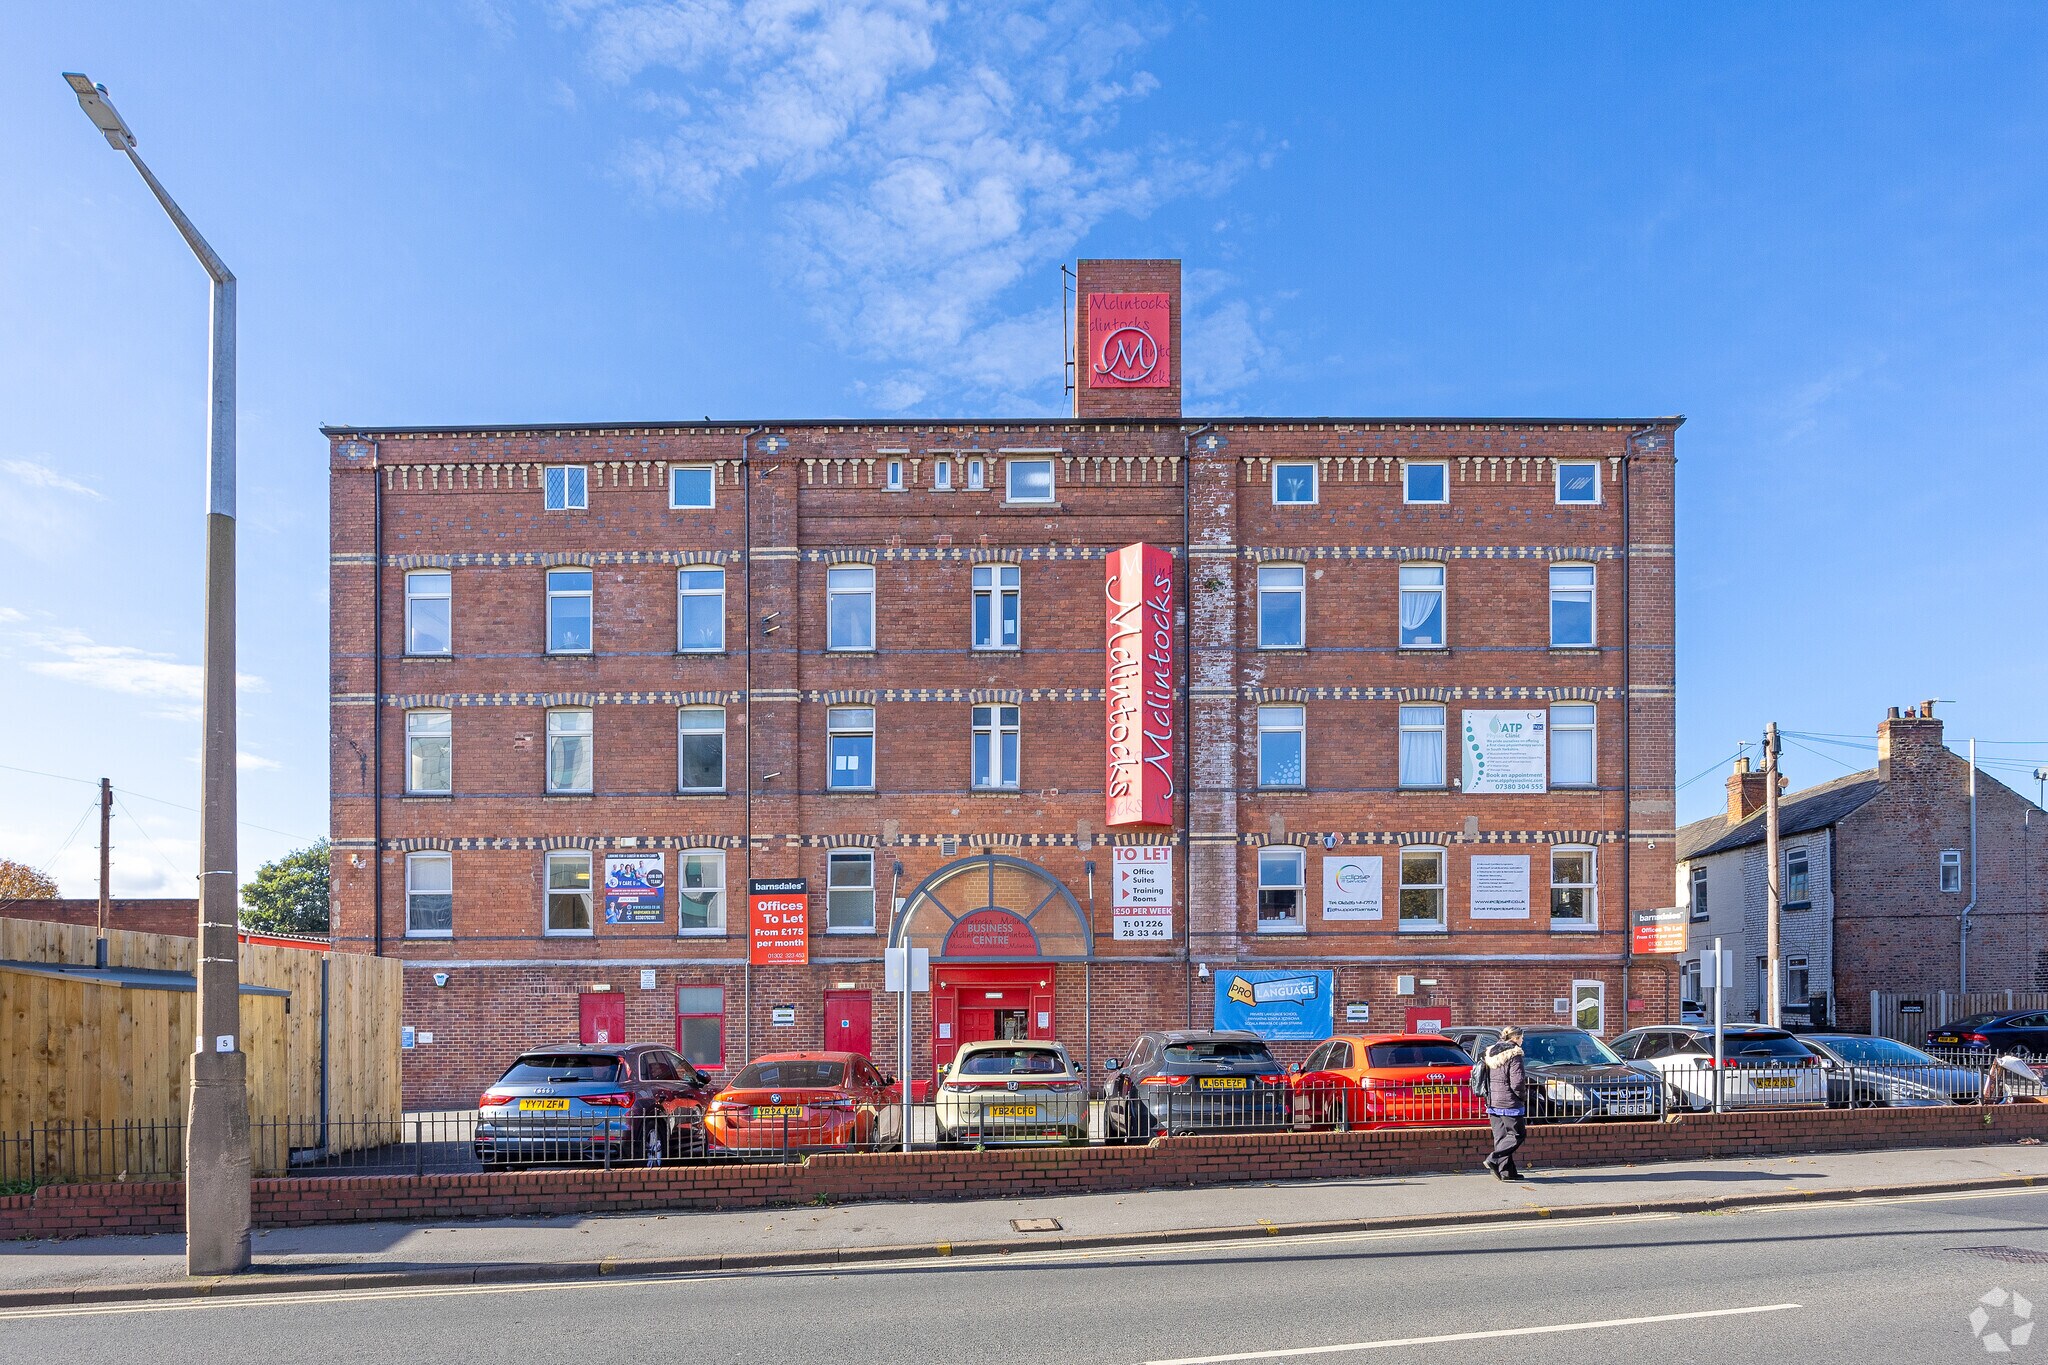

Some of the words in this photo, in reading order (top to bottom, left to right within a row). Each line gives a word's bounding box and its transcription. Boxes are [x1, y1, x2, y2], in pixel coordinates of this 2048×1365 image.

[1106, 576, 1142, 798] Mclintocks
[1144, 574, 1174, 799] Mclintocks
[1501, 724, 1522, 732] ATP
[1115, 848, 1137, 860] TO
[1144, 848, 1170, 860] LET
[758, 901, 803, 911] Offices
[763, 914, 779, 923] To
[783, 914, 803, 923] Let
[1640, 912, 1681, 921] barnsdales
[968, 924, 1013, 932] BUSINESS
[973, 936, 1009, 944] CENTRE
[1231, 984, 1251, 998] PRO
[1256, 986, 1315, 998] LANGUAGE
